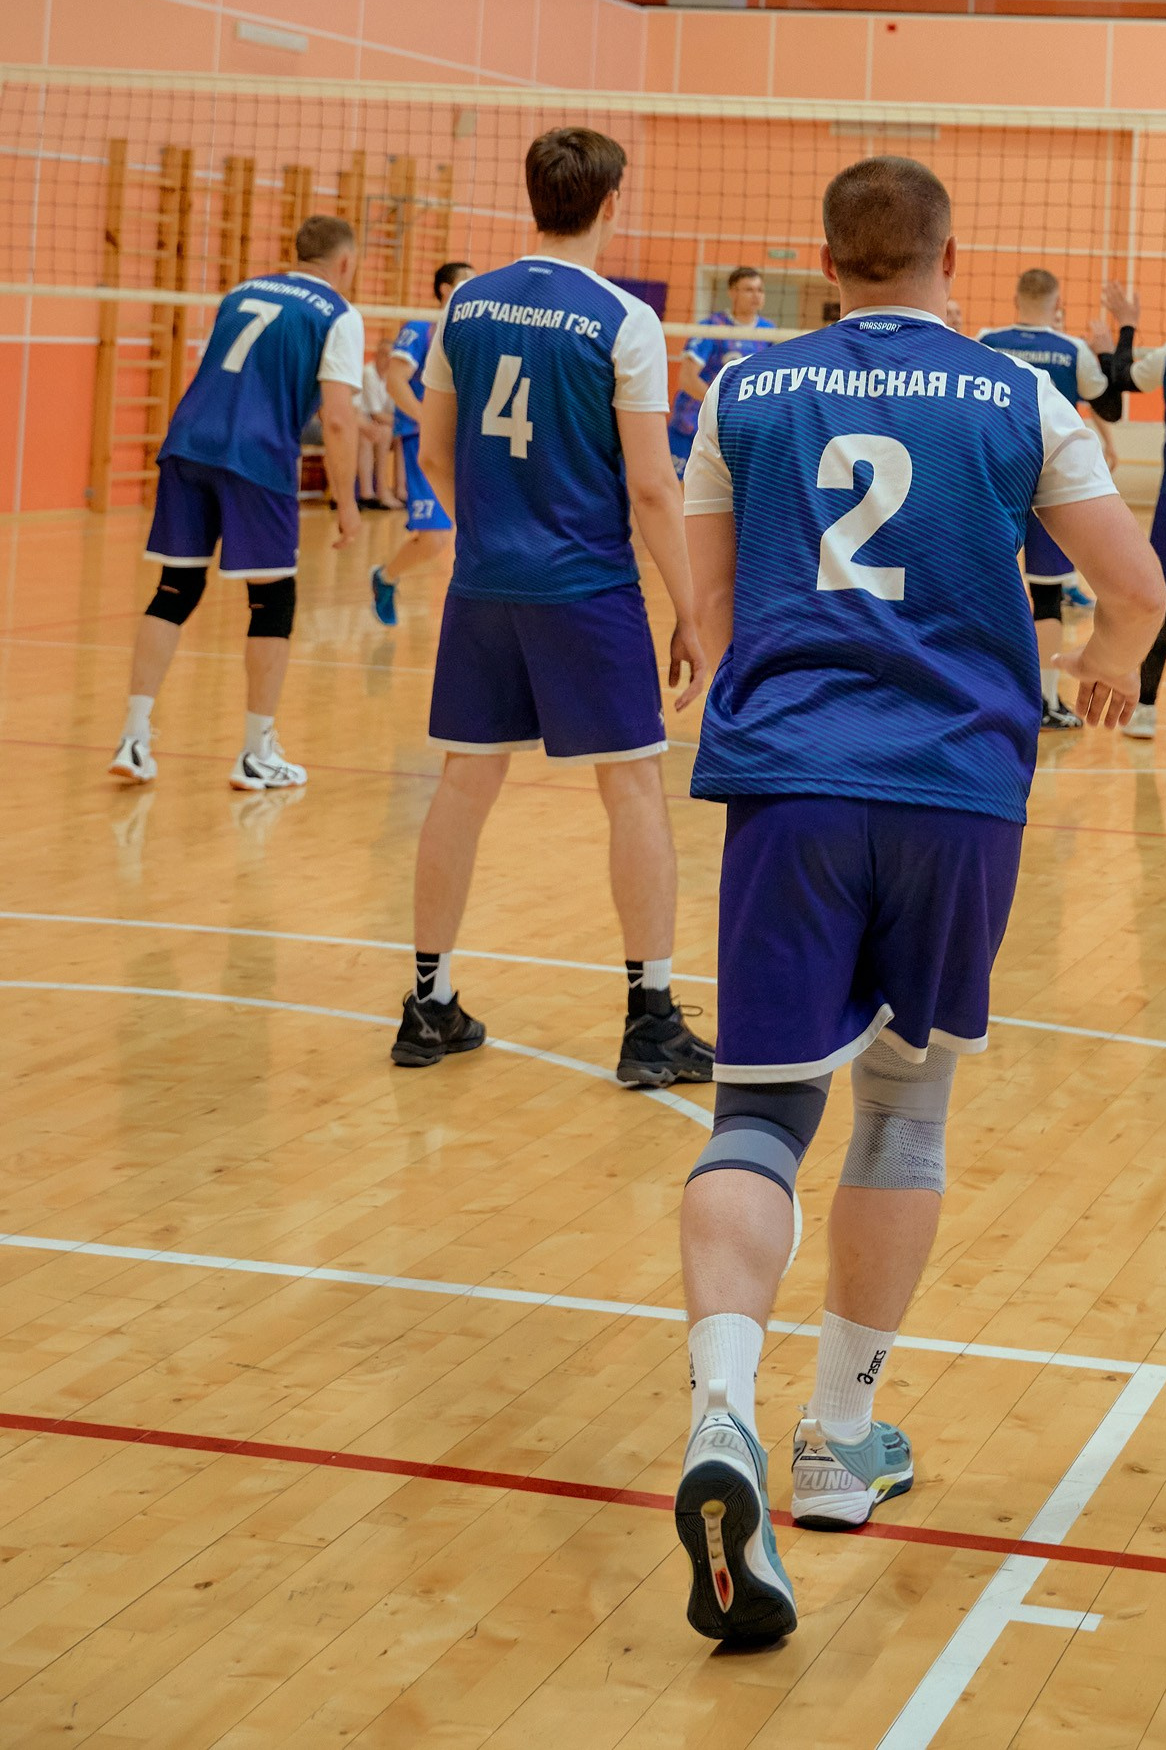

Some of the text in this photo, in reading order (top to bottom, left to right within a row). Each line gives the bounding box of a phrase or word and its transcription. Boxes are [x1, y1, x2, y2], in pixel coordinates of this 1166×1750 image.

[222, 298, 283, 373] 7
[452, 299, 602, 339] БОГУЧАНСКАЯ ГЭС
[859, 321, 902, 333] BARSSPORT
[481, 354, 534, 460] 4
[738, 366, 1012, 408] БОГУЧАНСКАЯ ГЭС
[411, 499, 435, 519] 27
[816, 433, 913, 601] 2
